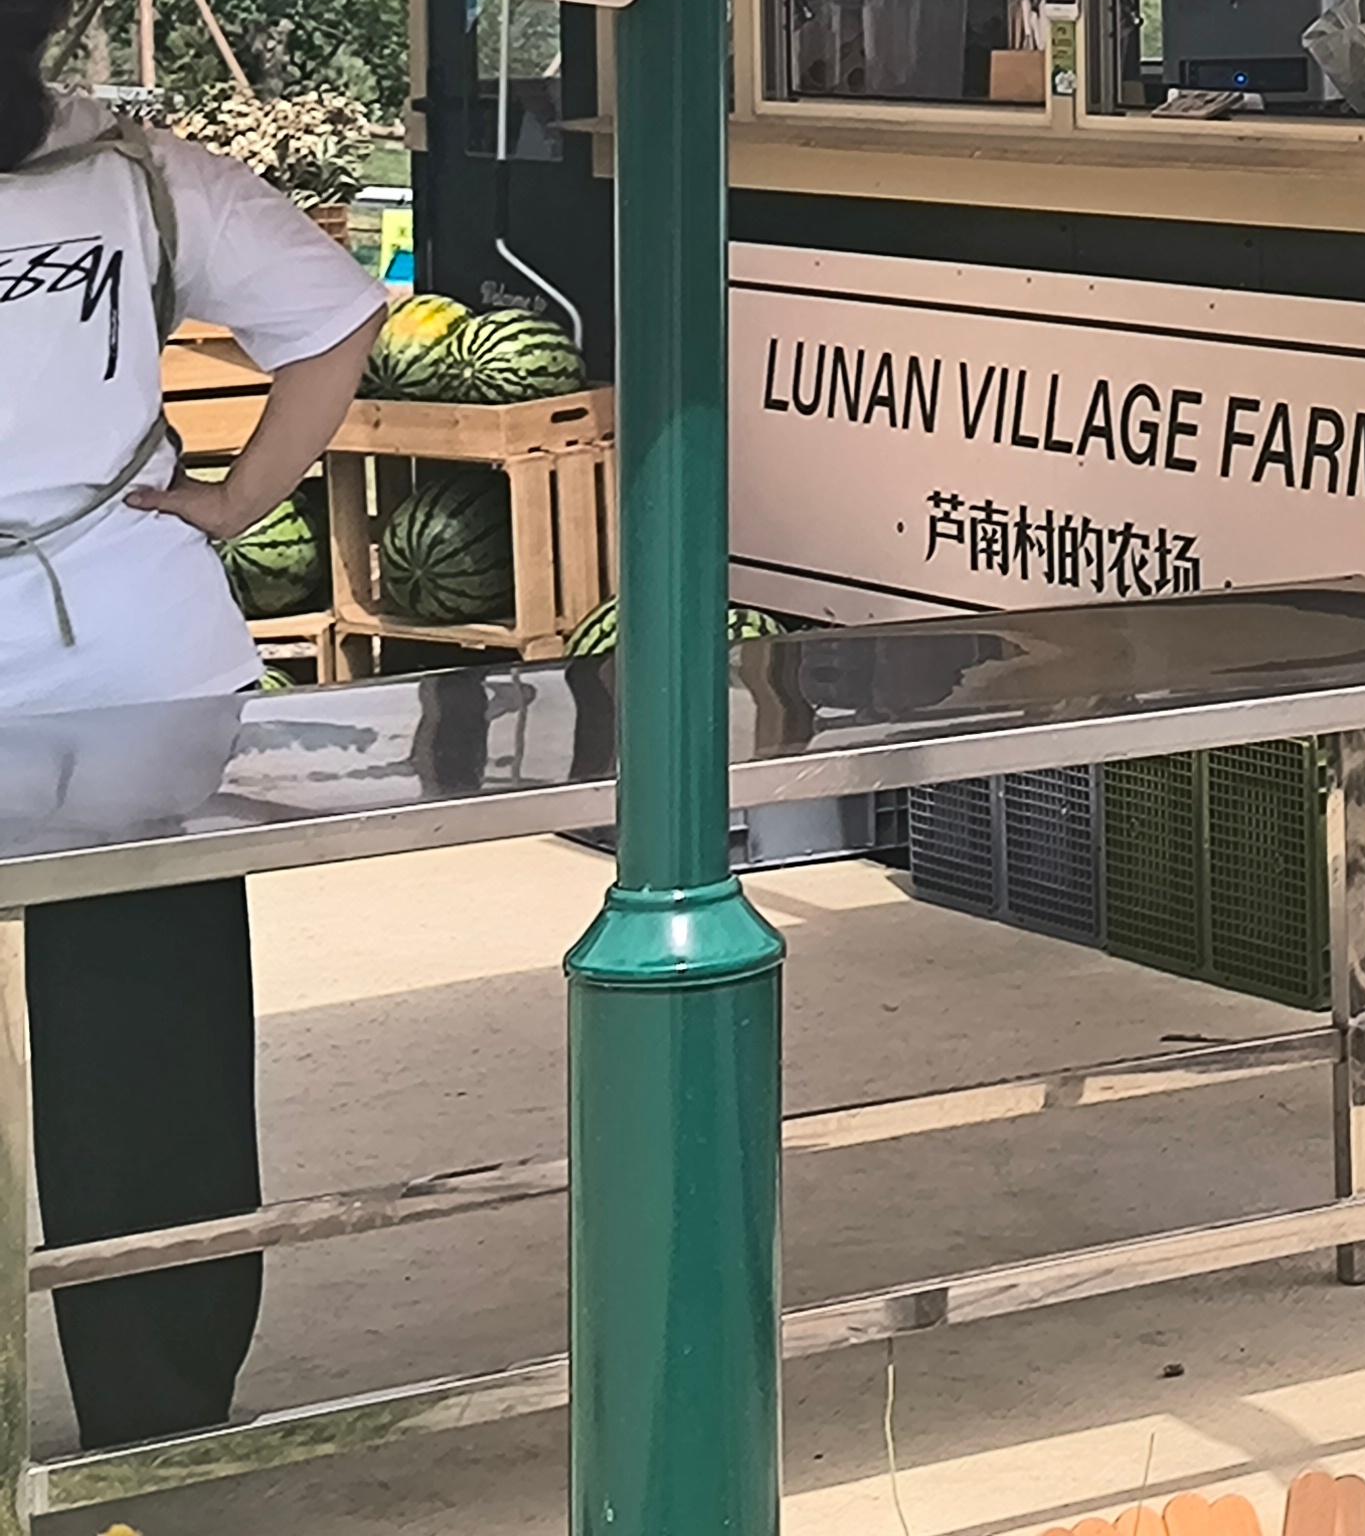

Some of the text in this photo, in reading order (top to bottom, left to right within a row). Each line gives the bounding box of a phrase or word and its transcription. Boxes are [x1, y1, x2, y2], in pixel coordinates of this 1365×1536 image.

[763, 338, 942, 434] LUNAN
[959, 361, 1203, 473] VILLAGE
[925, 489, 1201, 598] 芦南村的农场
